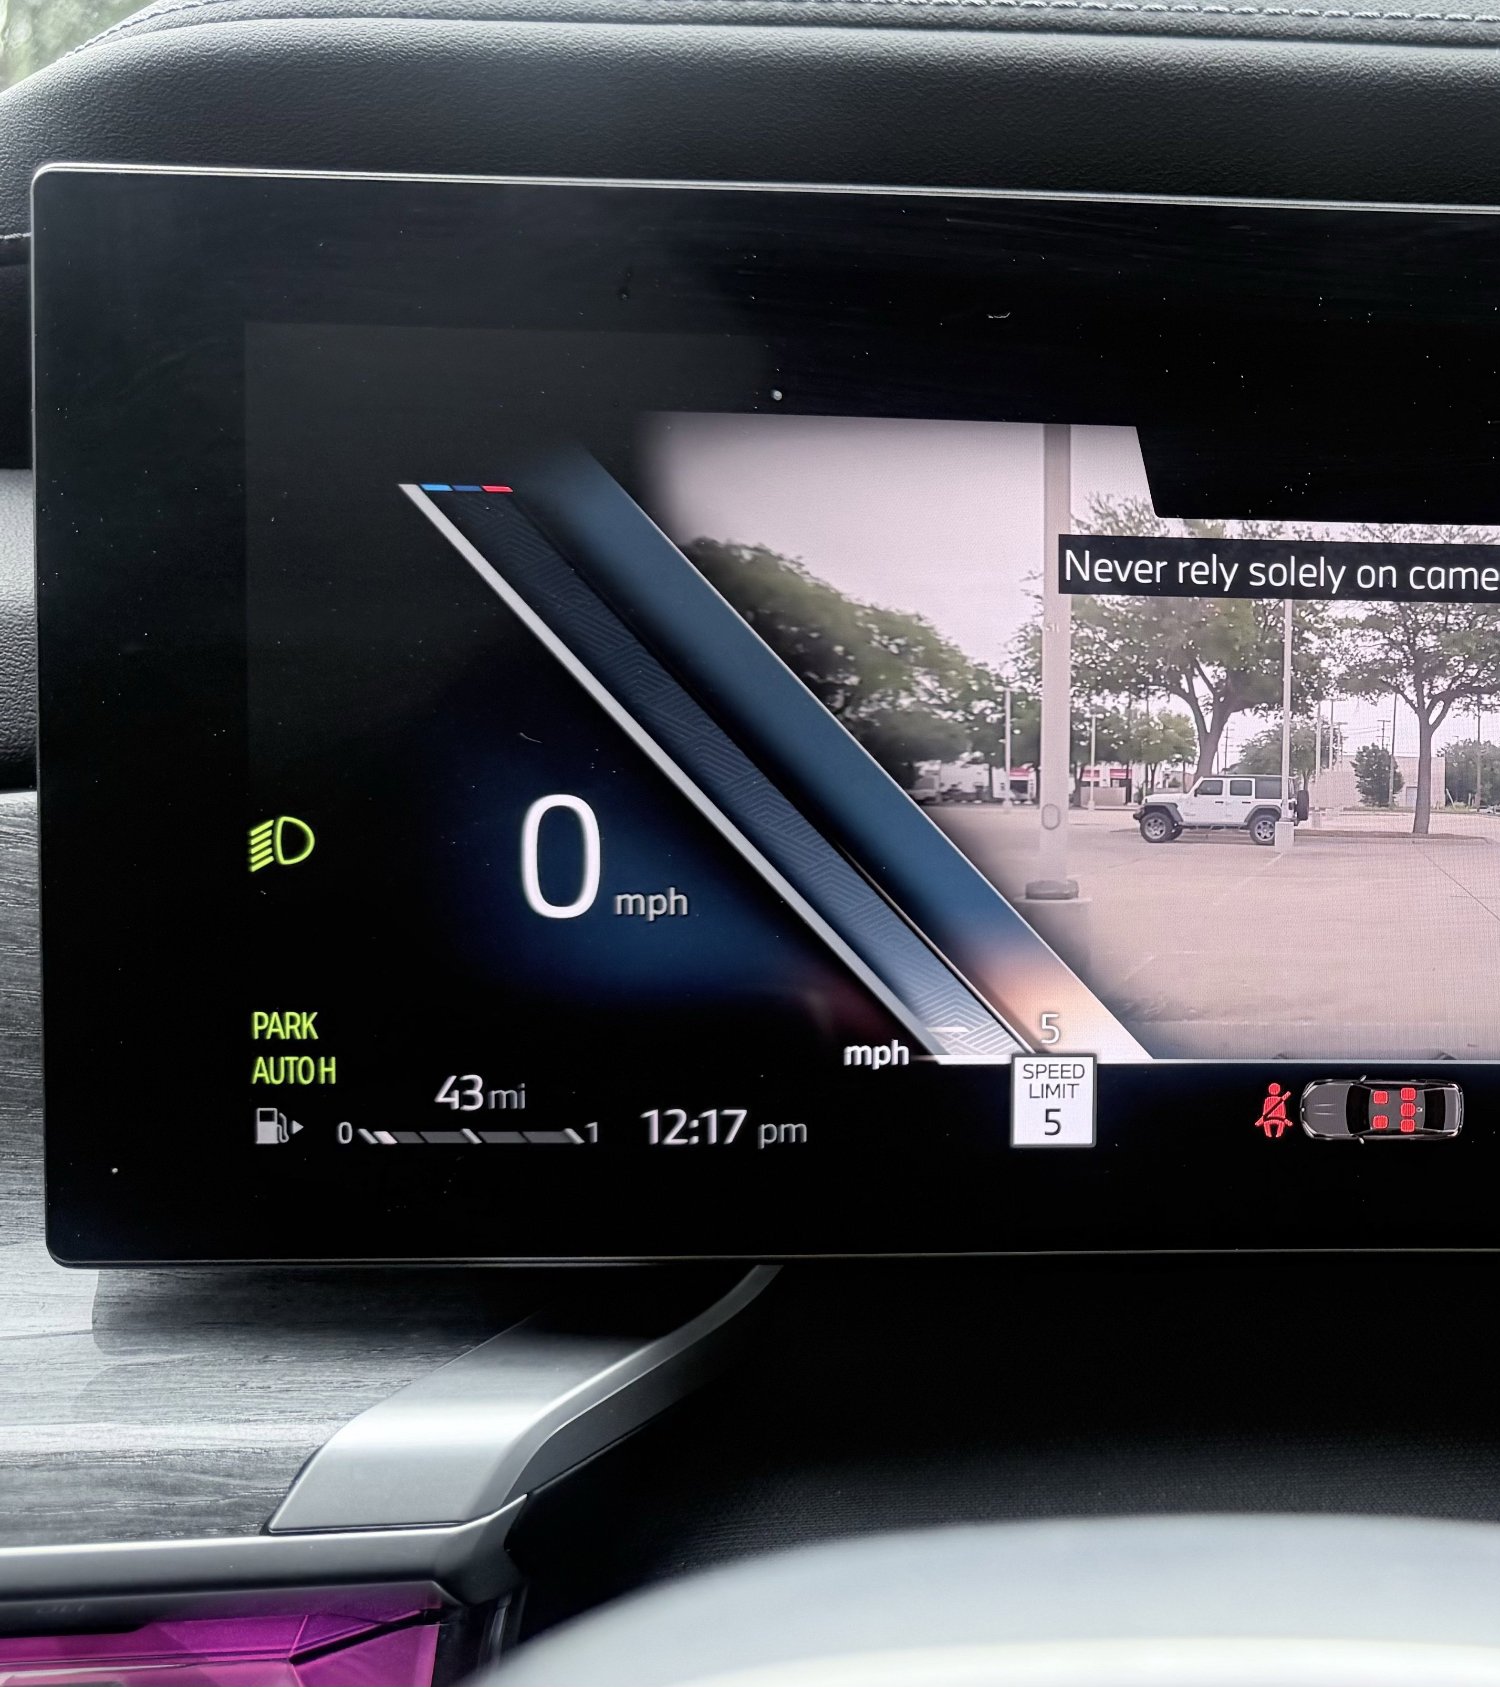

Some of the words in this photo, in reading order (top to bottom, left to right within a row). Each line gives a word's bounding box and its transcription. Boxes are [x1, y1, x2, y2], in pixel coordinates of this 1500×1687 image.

[1065, 549, 1168, 584] Never
[1177, 553, 1239, 592] rely
[1249, 555, 1347, 595] solely
[1356, 564, 1397, 590] on
[521, 794, 601, 919] 0
[614, 887, 688, 921] mph
[252, 1011, 319, 1040] PARK
[1040, 1012, 1060, 1045] 5
[844, 1039, 909, 1070] mph
[252, 1055, 315, 1085] AUTO
[1022, 1063, 1086, 1080] SPEED
[1028, 1083, 1080, 1099] LIMIT
[337, 1121, 353, 1145] 0
[584, 1121, 599, 1144] 1
[641, 1108, 748, 1145] 12:17
[757, 1123, 808, 1150] pm
[1044, 1108, 1063, 1136] 5
